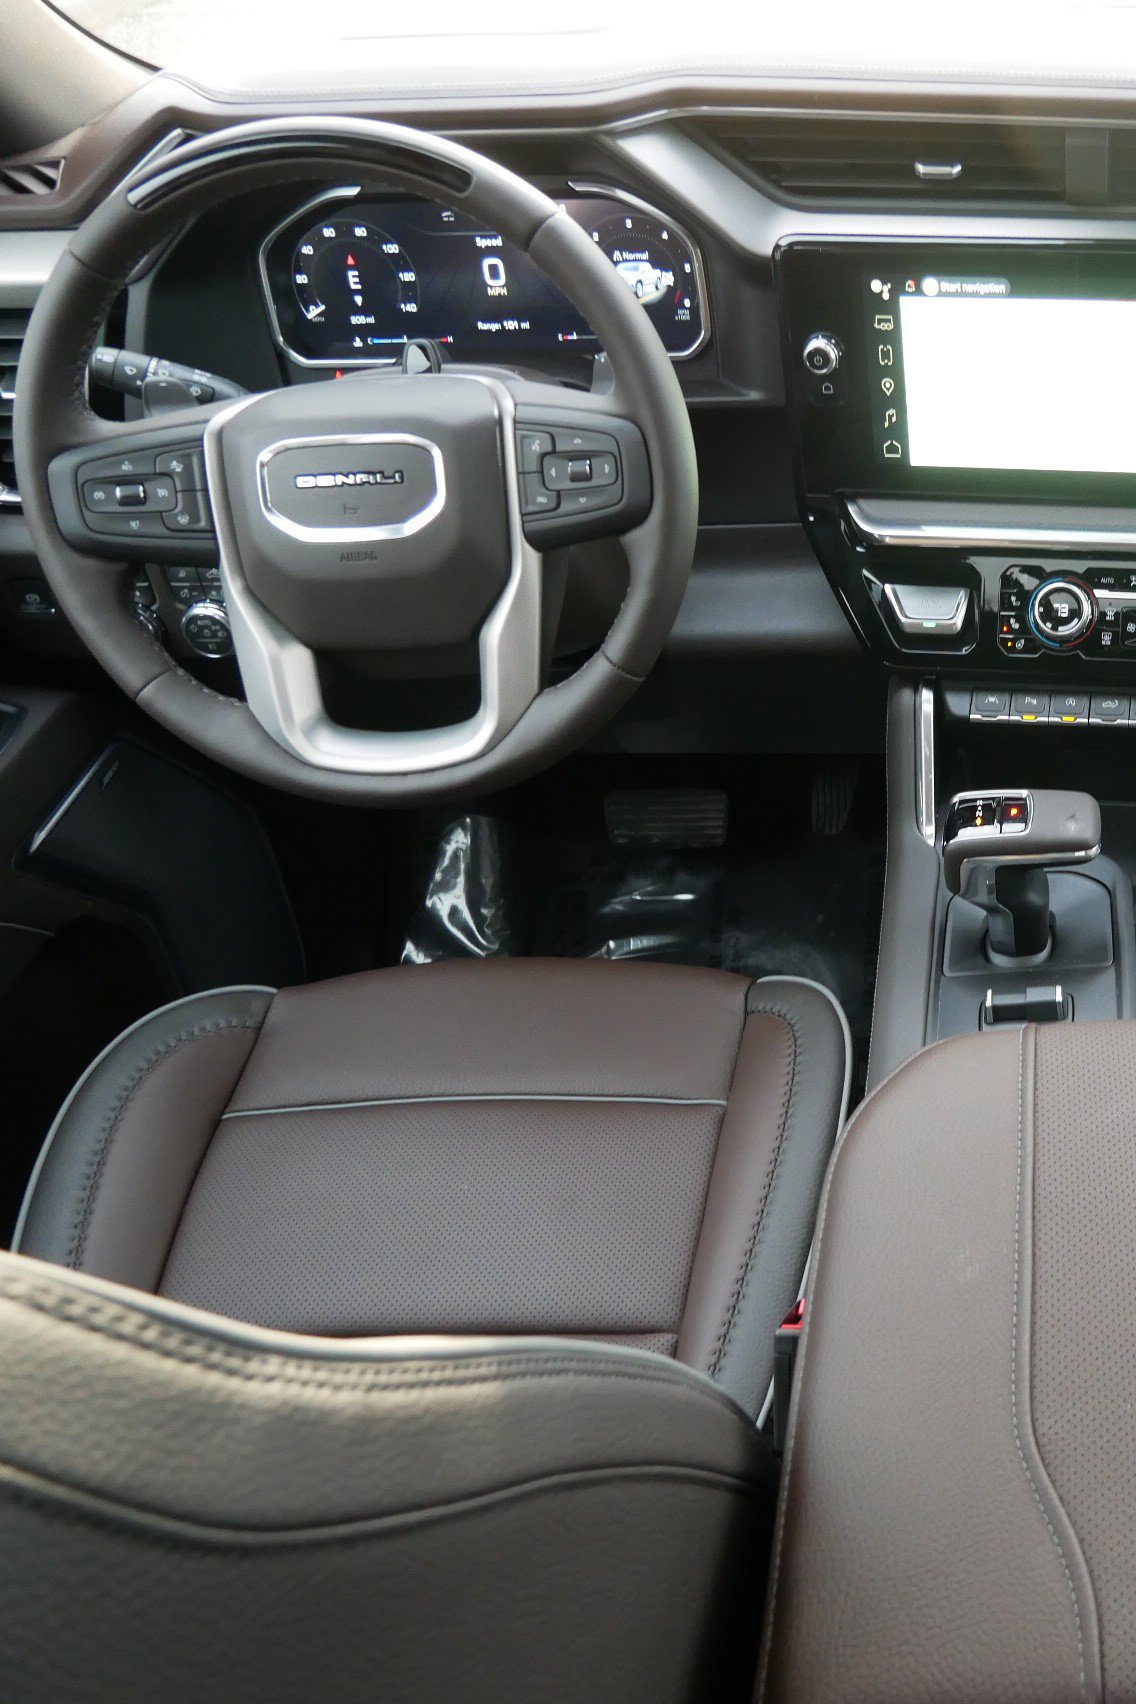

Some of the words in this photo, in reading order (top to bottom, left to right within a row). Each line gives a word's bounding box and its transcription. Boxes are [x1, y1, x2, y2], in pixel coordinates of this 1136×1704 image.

[662, 231, 668, 240] 4
[383, 243, 400, 254] 100
[475, 236, 503, 249] Speed
[301, 244, 314, 255] 40
[623, 251, 649, 260] Normal
[482, 257, 506, 287] 0
[348, 270, 362, 290] E
[487, 286, 508, 297] MPH
[940, 281, 961, 293] Start
[962, 283, 1006, 296] navigation
[401, 303, 418, 313] 140
[477, 321, 502, 332] Range:
[503, 320, 519, 331] 101
[520, 321, 530, 330] mi
[295, 470, 404, 489] DENALI
[1053, 603, 1069, 618] 73
